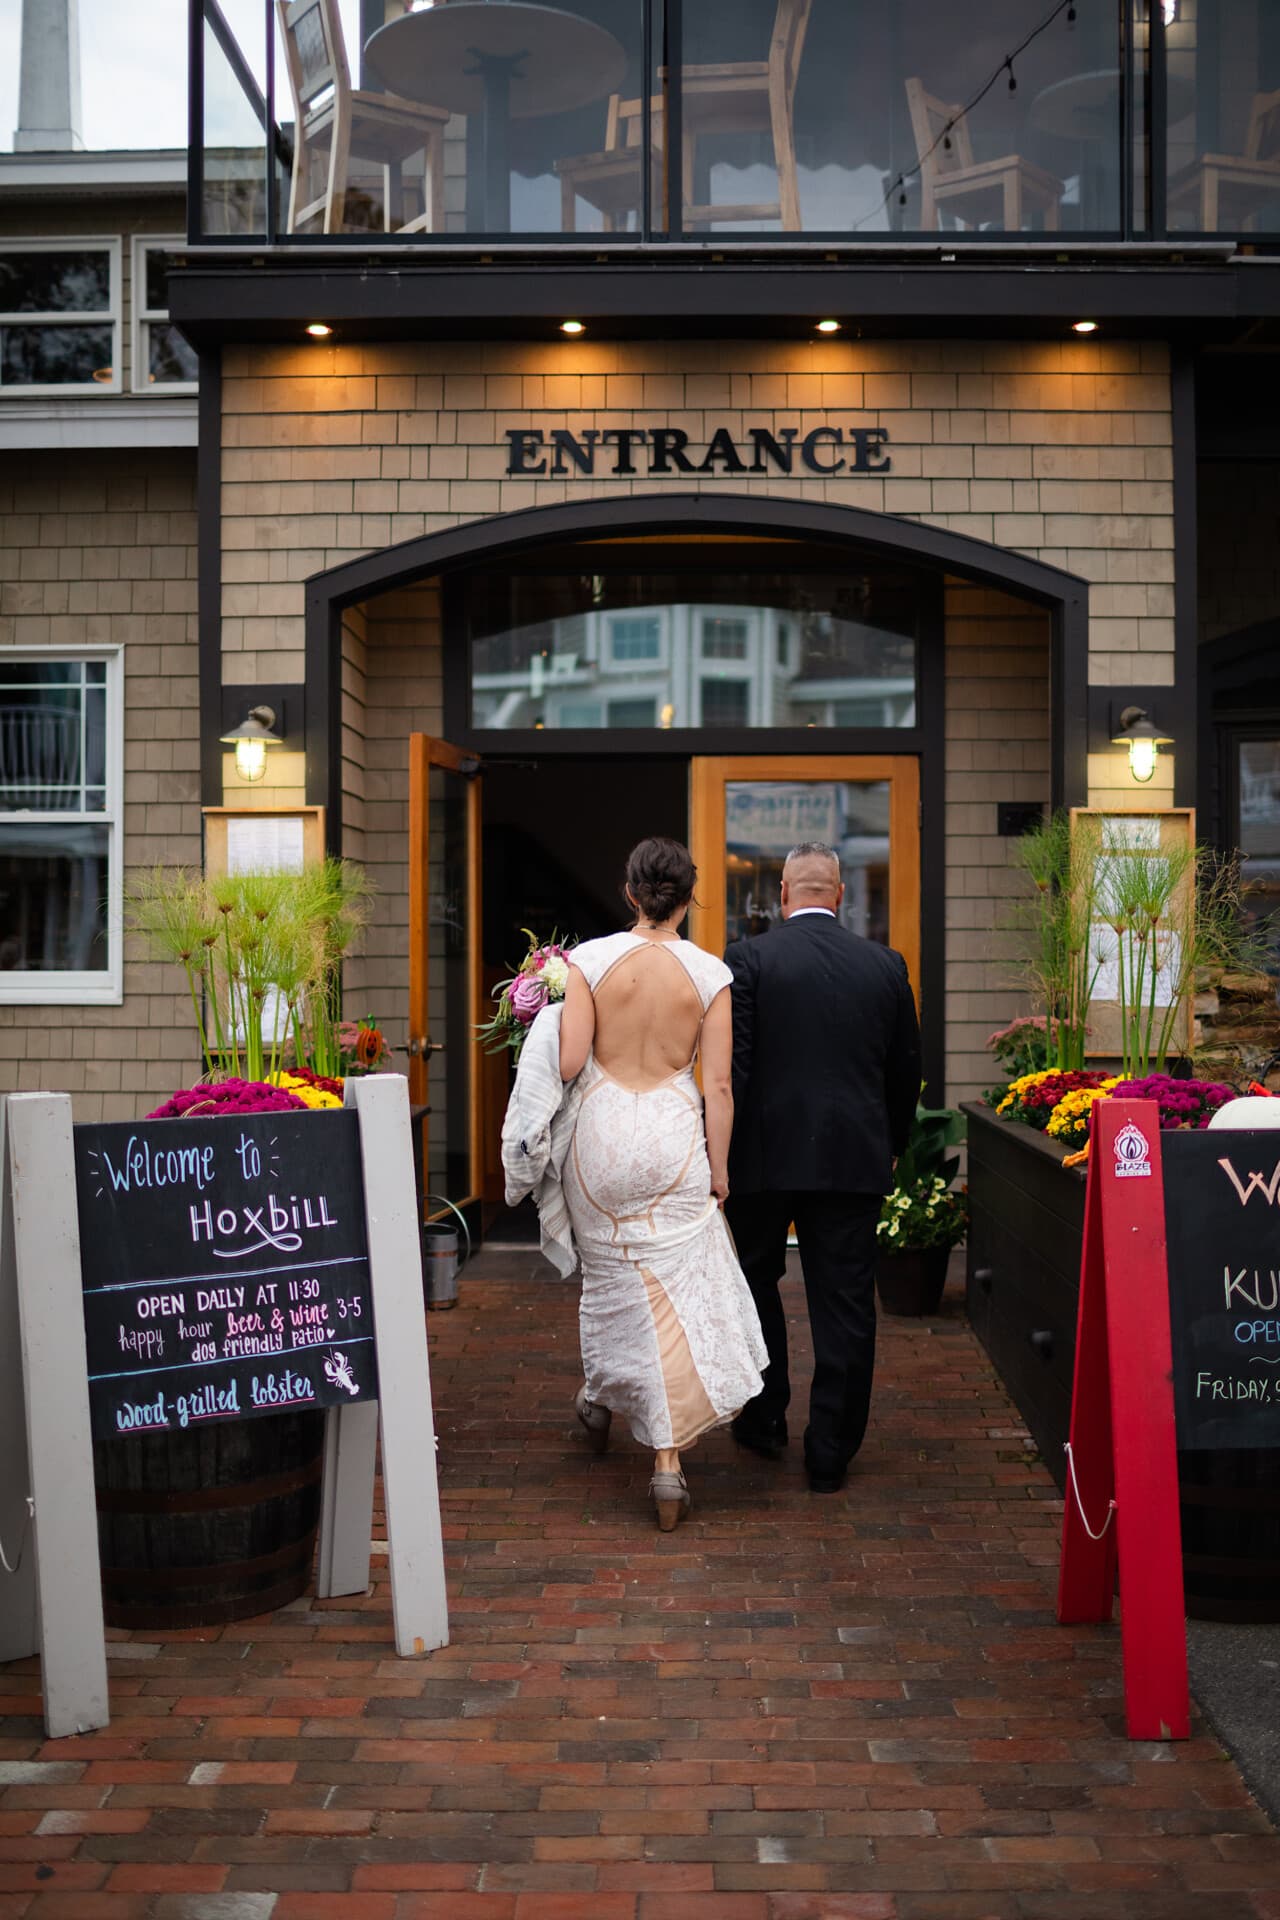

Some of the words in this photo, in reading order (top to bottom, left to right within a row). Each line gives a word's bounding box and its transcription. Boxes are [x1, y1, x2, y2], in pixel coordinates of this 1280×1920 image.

[505, 426, 891, 475] ENTRANCE
[103, 1136, 216, 1192] Welcome
[235, 1133, 262, 1181] to
[1115, 1162, 1150, 1171] BLAZE
[1217, 1157, 1280, 1207] W
[137, 1294, 185, 1319] OPEN
[197, 1287, 246, 1312] DAILY
[256, 1284, 279, 1306] AT
[288, 1279, 321, 1302] 11:30
[1224, 1265, 1280, 1311] KU
[118, 1325, 165, 1360] happy
[178, 1319, 214, 1341] hour
[225, 1312, 266, 1338] beer
[270, 1308, 285, 1330] &
[290, 1302, 330, 1327] wine
[336, 1296, 362, 1318] 3-5
[191, 1341, 217, 1363] dog
[222, 1332, 284, 1358] friendly
[292, 1327, 325, 1348] patio
[116, 1379, 241, 1429] wood-grilled
[250, 1369, 315, 1407] lobster
